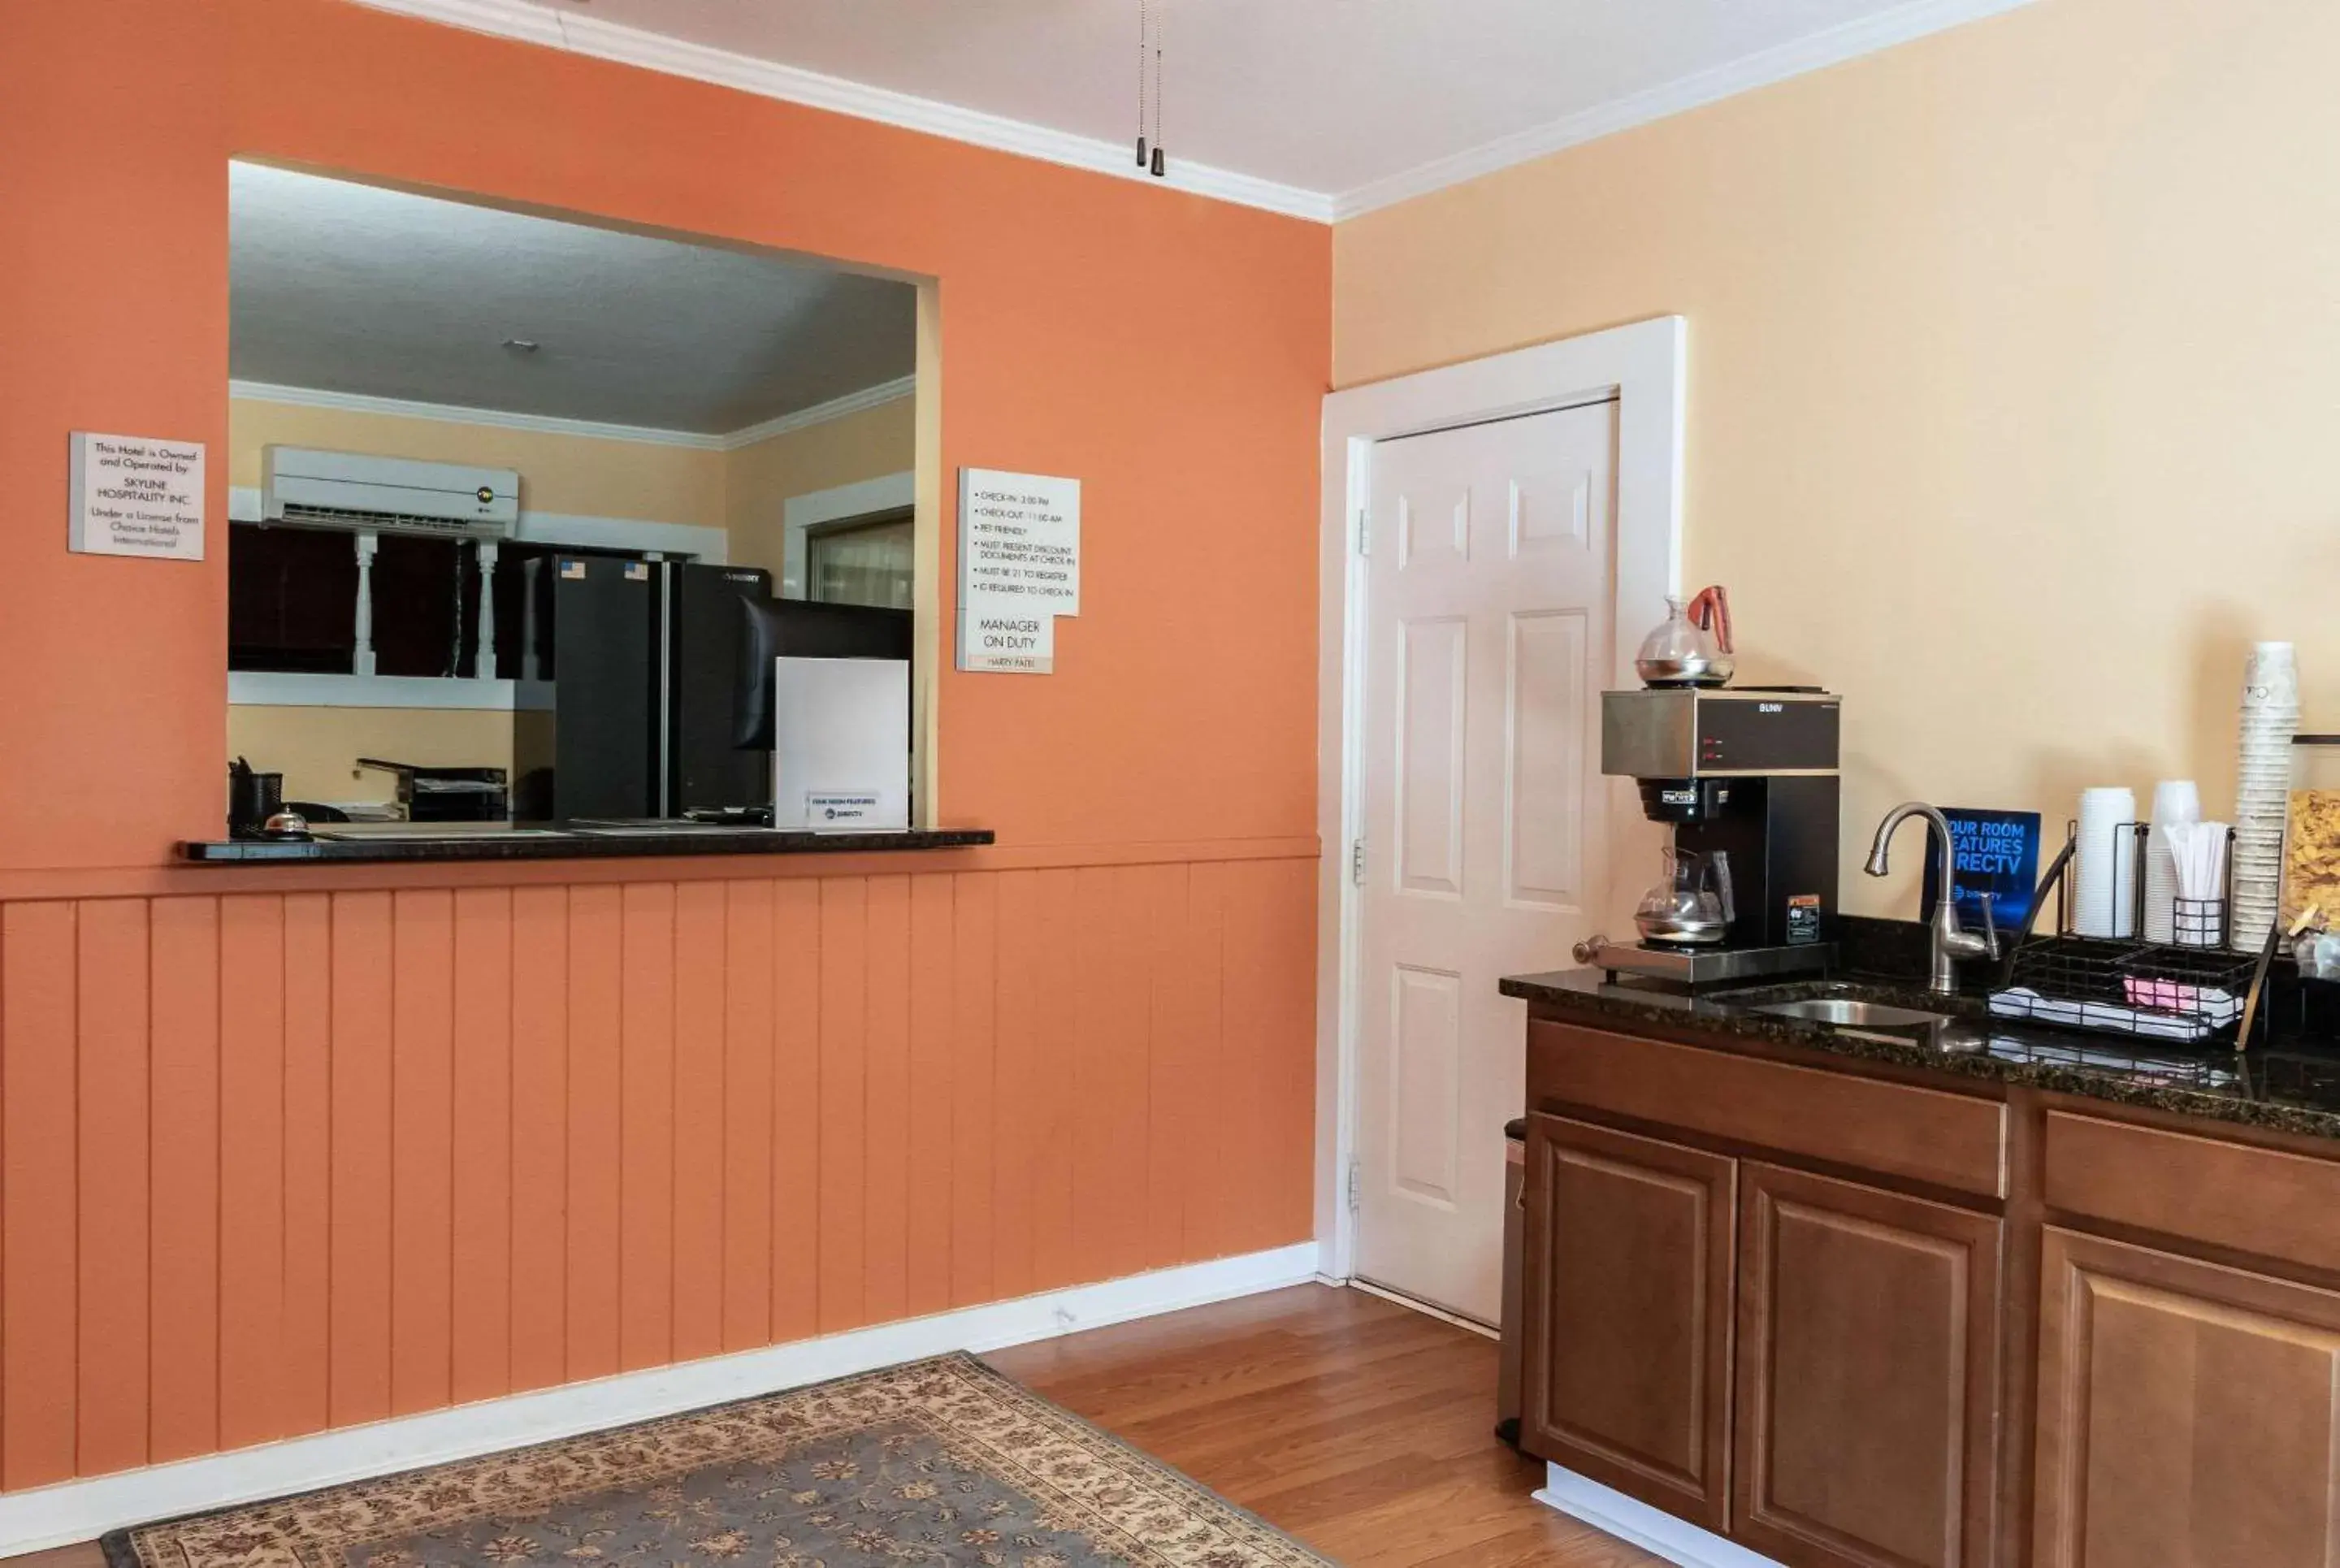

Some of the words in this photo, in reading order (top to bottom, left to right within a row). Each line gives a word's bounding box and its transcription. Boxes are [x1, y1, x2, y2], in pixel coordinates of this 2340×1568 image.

[96, 443, 115, 453] This
[119, 446, 145, 457] Hotel
[159, 448, 197, 461] Owned
[100, 458, 120, 467] and
[124, 458, 172, 472] Operated
[98, 489, 165, 502] HOSPITALITY
[91, 507, 123, 518] Under
[136, 511, 171, 522] License
[176, 513, 198, 524] from
[150, 526, 180, 535] Hotels
[114, 535, 177, 548] International
[980, 540, 1001, 549] MUST
[1003, 542, 1032, 552] PRESENT
[1034, 544, 1071, 555] DISCOUNT
[981, 551, 1027, 561] DOCUMENTS
[980, 568, 1000, 576] MUST
[1024, 570, 1034, 578] TO
[989, 583, 1025, 593] REQUIRED
[1027, 586, 1038, 595] TO
[981, 619, 1040, 632] MANAGER
[984, 635, 1003, 648] ON
[1008, 636, 1037, 648] DUTY
[1981, 822, 2025, 838] ROOM
[1953, 835, 2023, 855] EATURES
[1956, 852, 2022, 874] RECTV
